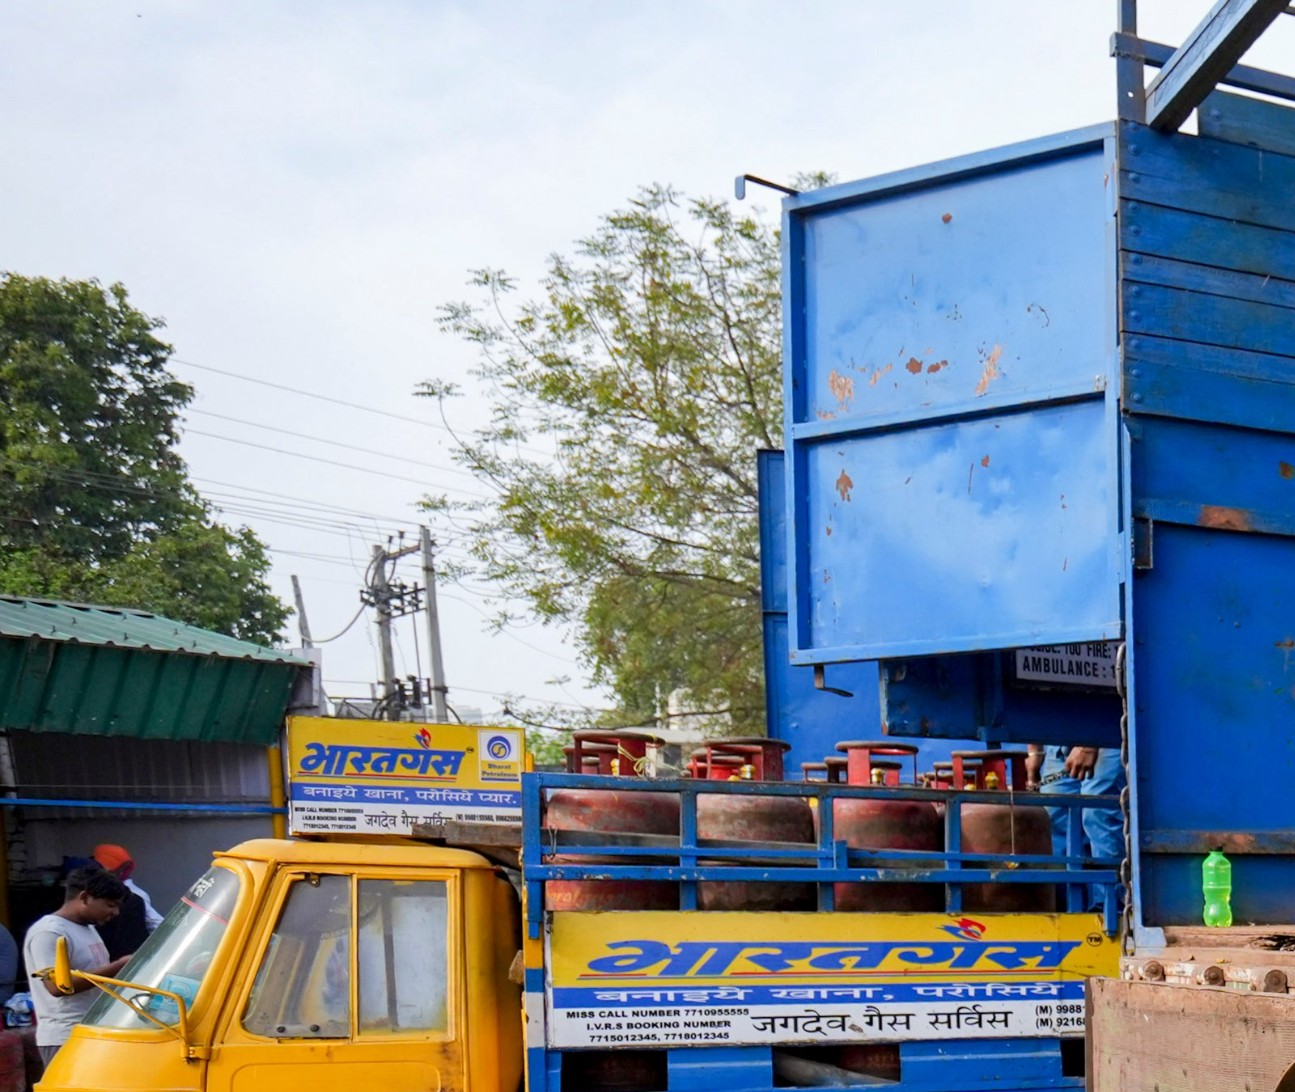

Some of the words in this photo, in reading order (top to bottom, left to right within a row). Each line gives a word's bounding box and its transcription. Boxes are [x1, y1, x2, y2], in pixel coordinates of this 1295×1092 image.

[1023, 656, 1099, 678] AMBULANCE
[303, 785, 357, 799] बनाइये
[364, 812, 397, 829] जगदेव
[580, 918, 1082, 978] भारतगैस
[594, 986, 751, 1004] बनाइये
[769, 986, 894, 1001] खाना,
[912, 982, 1065, 999] परोसिये
[566, 1010, 596, 1019] MISS
[598, 1010, 628, 1018] CALL
[632, 1009, 681, 1018] NUMBER
[1035, 1003, 1053, 1016] (M)
[586, 1022, 623, 1031] I.V.R.S
[626, 1021, 680, 1029] BOOKING
[683, 1020, 731, 1029] NUMBER
[750, 1009, 851, 1036] जगदेव
[863, 1005, 915, 1032] गैस
[927, 1004, 1014, 1030] सर्विस
[1036, 1016, 1053, 1028] (M)
[589, 1033, 660, 1043] 7715012345,
[664, 1032, 730, 1040] 7718012345
